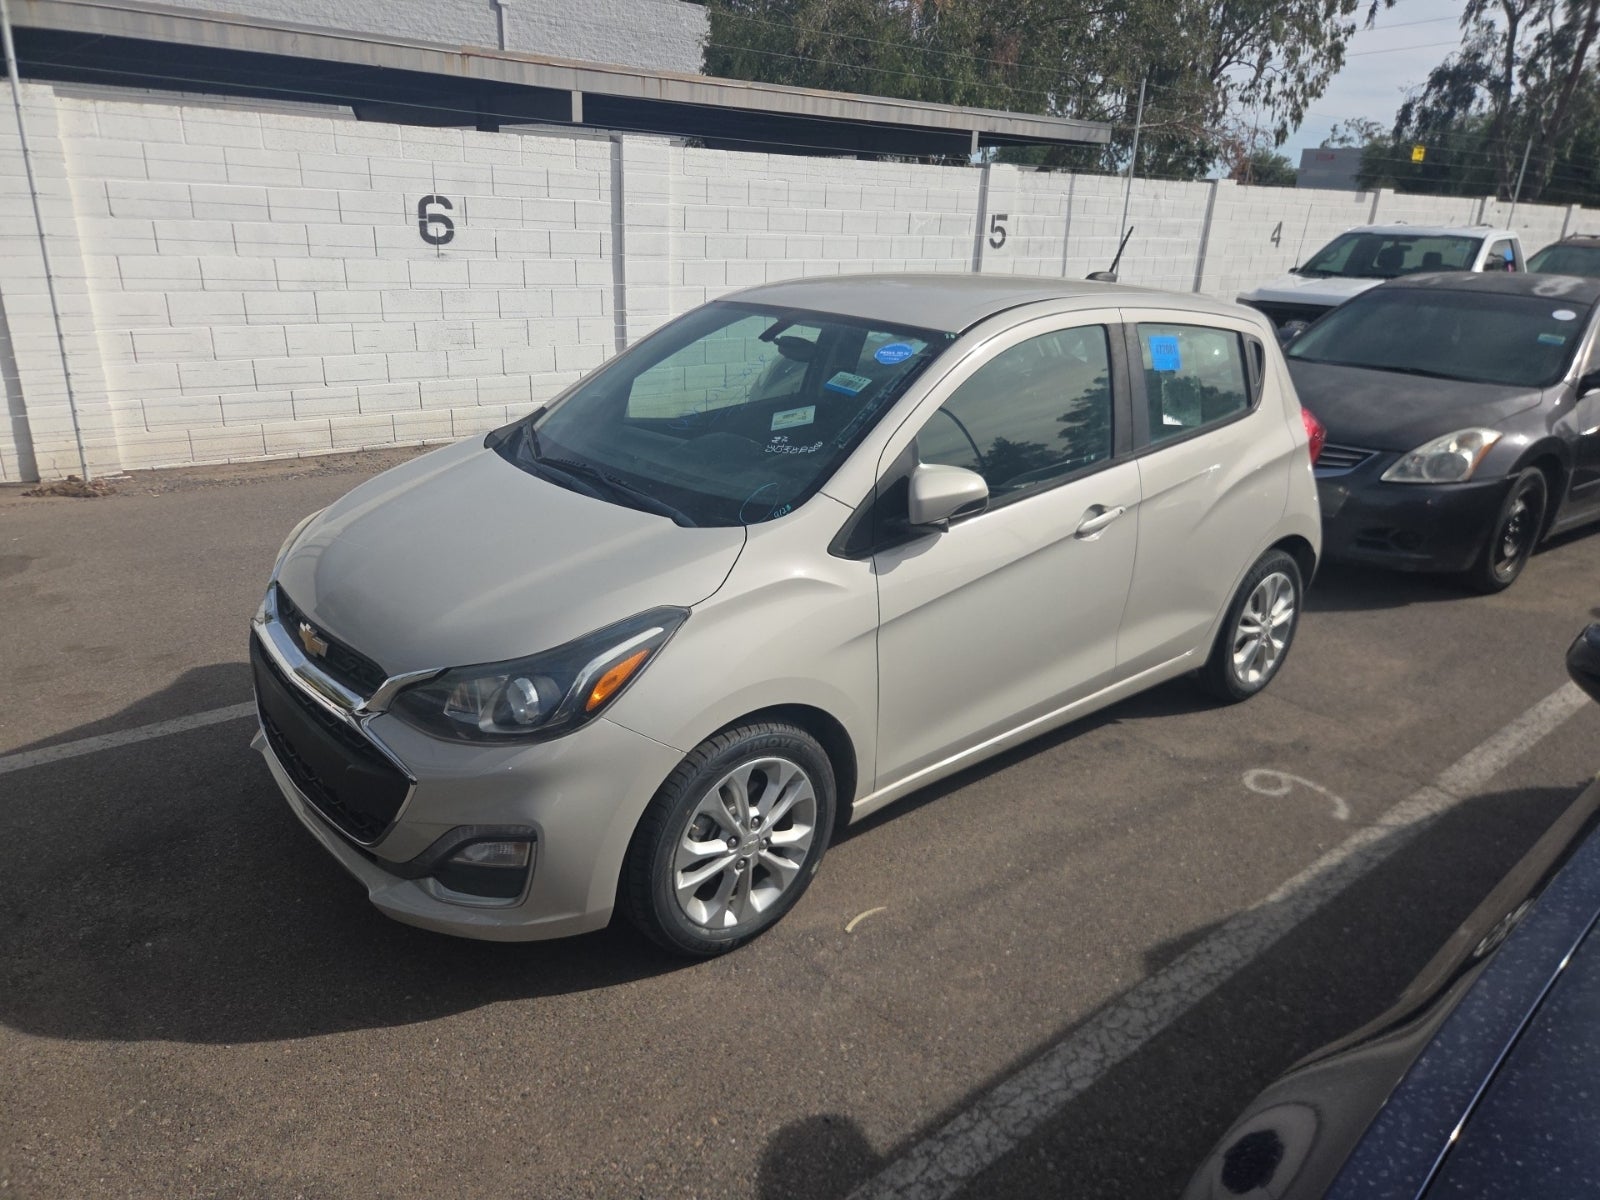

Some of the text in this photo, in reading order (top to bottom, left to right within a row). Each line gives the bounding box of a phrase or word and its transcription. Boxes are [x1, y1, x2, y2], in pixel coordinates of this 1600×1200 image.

[418, 195, 454, 245] 6
[989, 214, 1008, 249] 5
[1270, 221, 1283, 248] 4
